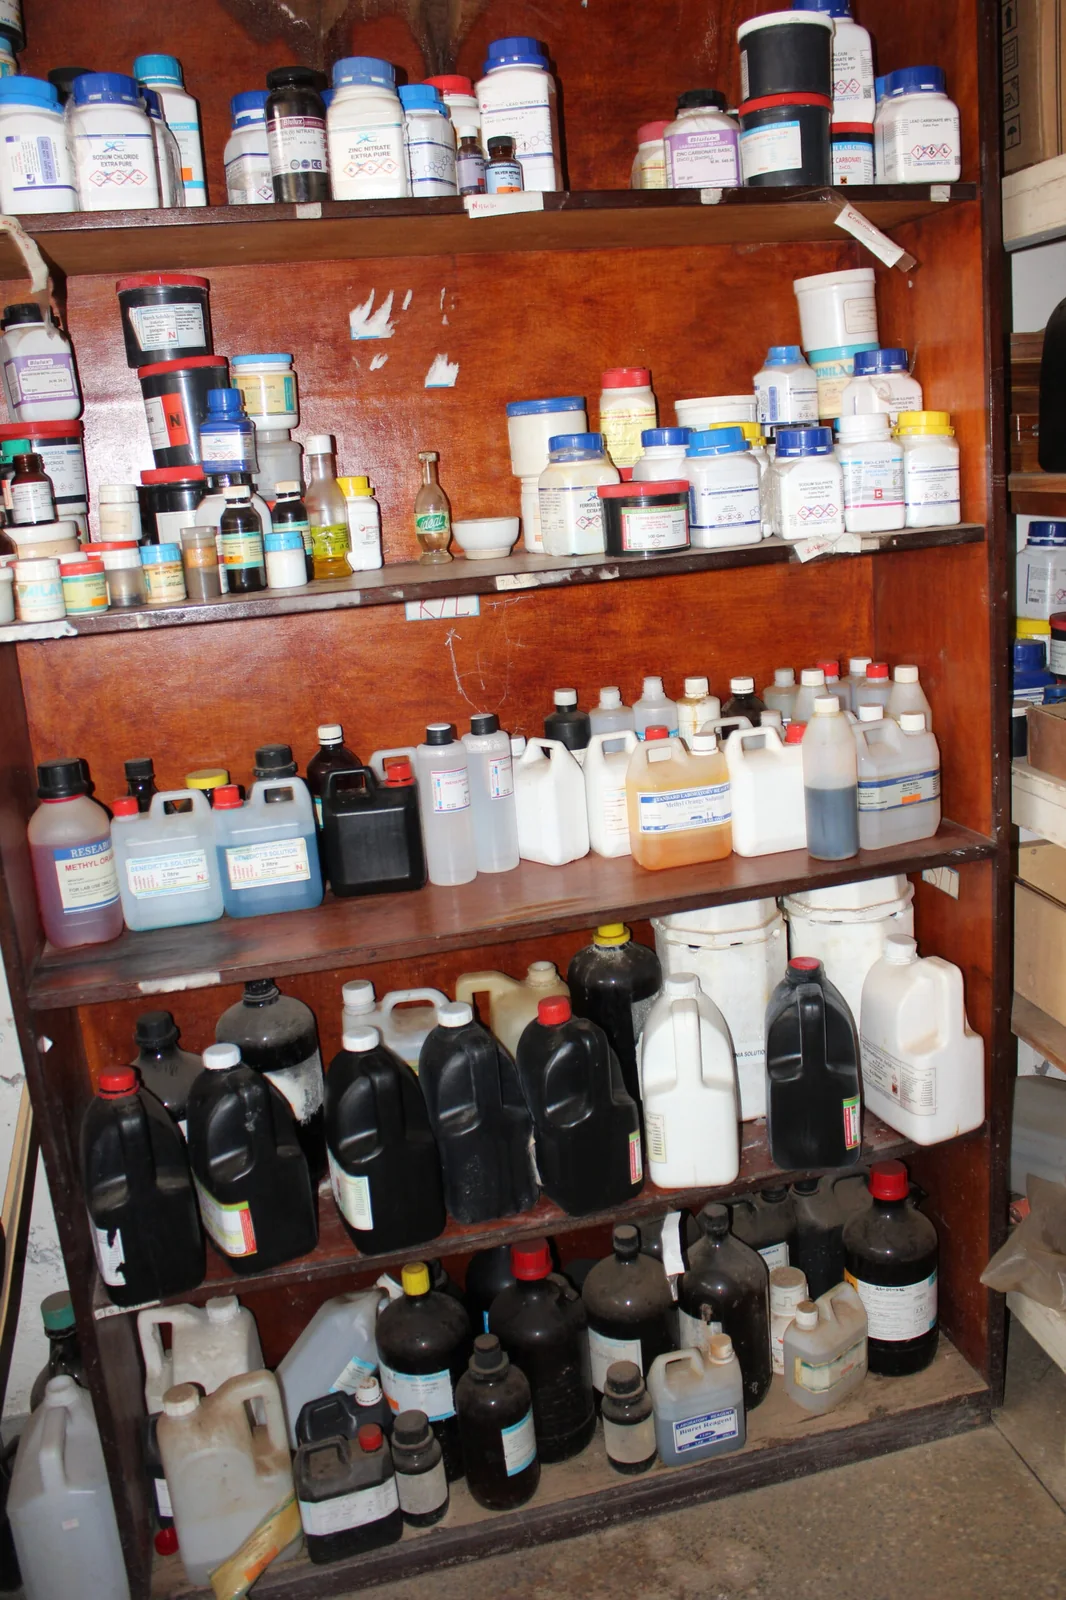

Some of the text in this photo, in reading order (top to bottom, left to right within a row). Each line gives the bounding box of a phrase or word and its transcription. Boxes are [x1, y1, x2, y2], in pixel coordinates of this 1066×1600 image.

[169, 414, 181, 428] N
[420, 516, 444, 529] ideal
[681, 788, 713, 799] LABORATORY
[666, 801, 684, 809] Methyl
[269, 848, 298, 857] SOLUTION
[65, 860, 99, 871] METHYL
[170, 856, 203, 868] SOLUTION
[677, 1410, 733, 1429] LABORATORY REAGENT
[679, 1416, 732, 1436] Biuret Reagent
